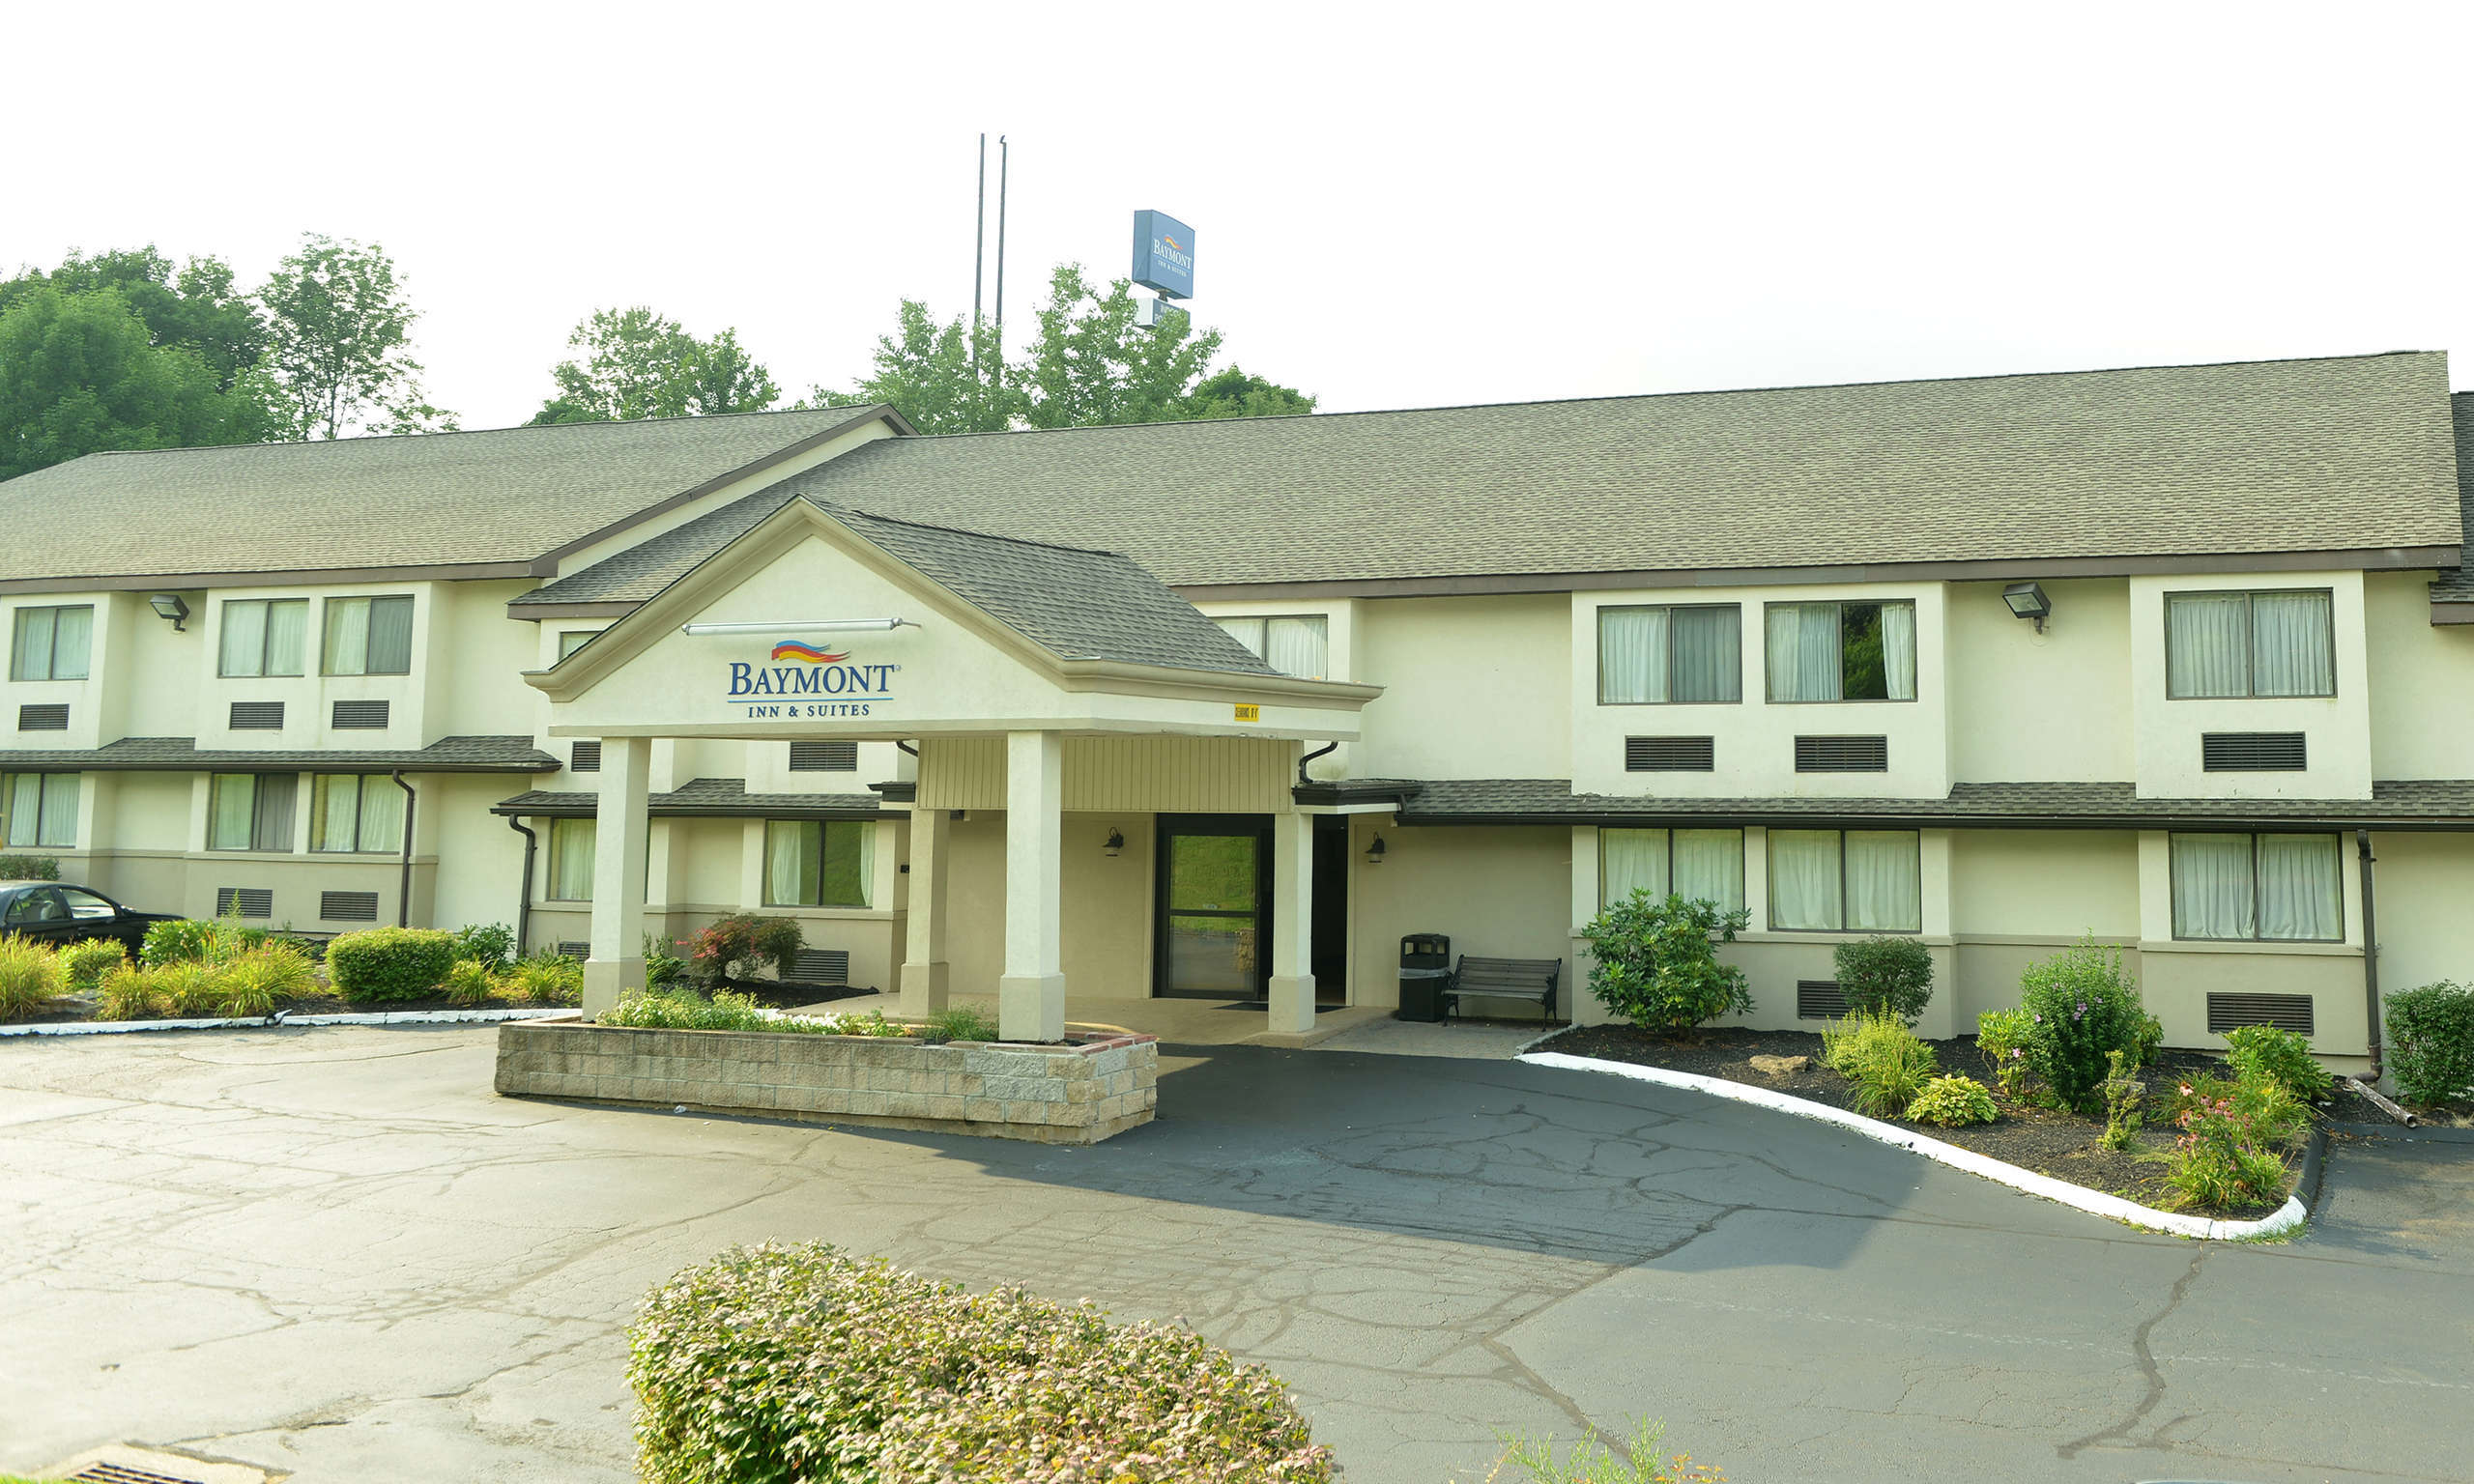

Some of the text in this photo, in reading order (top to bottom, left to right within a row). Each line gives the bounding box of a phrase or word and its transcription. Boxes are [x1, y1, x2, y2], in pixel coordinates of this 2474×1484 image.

[1153, 239, 1191, 269] BAYMONT
[728, 663, 895, 696] BAYMONT
[748, 703, 870, 718] INN & SUITES
